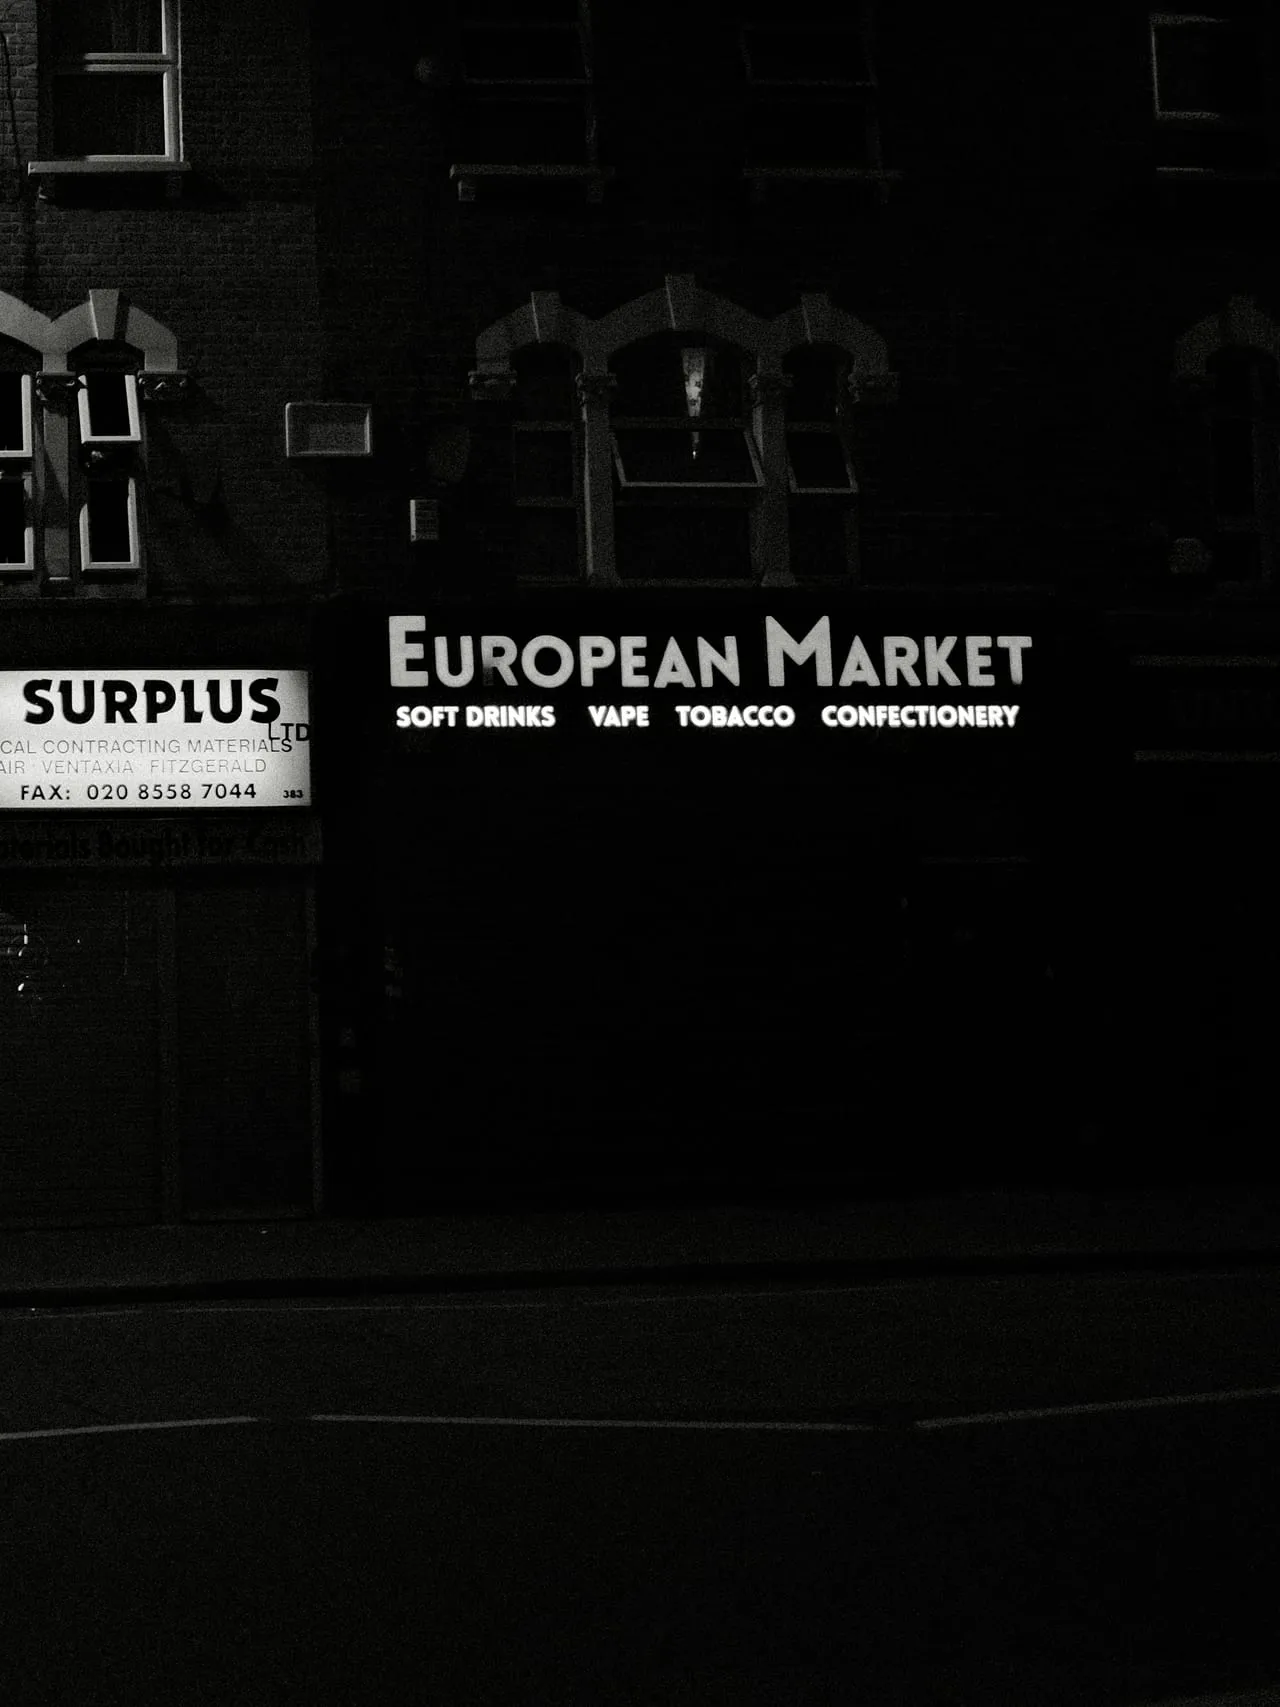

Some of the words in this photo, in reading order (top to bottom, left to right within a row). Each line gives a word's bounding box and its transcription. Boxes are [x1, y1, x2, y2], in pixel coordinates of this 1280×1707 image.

[23, 677, 281, 725] SURPLUS
[396, 705, 459, 728] SOFT
[466, 705, 557, 728] DRINKS
[588, 705, 650, 728] VAPE
[676, 705, 796, 728] TOBACCO
[821, 705, 1020, 728] CONFECTIONERY
[269, 722, 311, 743] LTD
[43, 739, 181, 754] CONTRACTING
[187, 738, 293, 753] MATERIALS
[42, 759, 134, 774] VENTAXIA
[151, 758, 267, 773] FITZGERALD
[21, 784, 70, 800] FAX:
[86, 784, 128, 799] 020
[138, 784, 192, 799] 8558
[201, 783, 256, 799] 7044
[282, 789, 304, 799] 383
